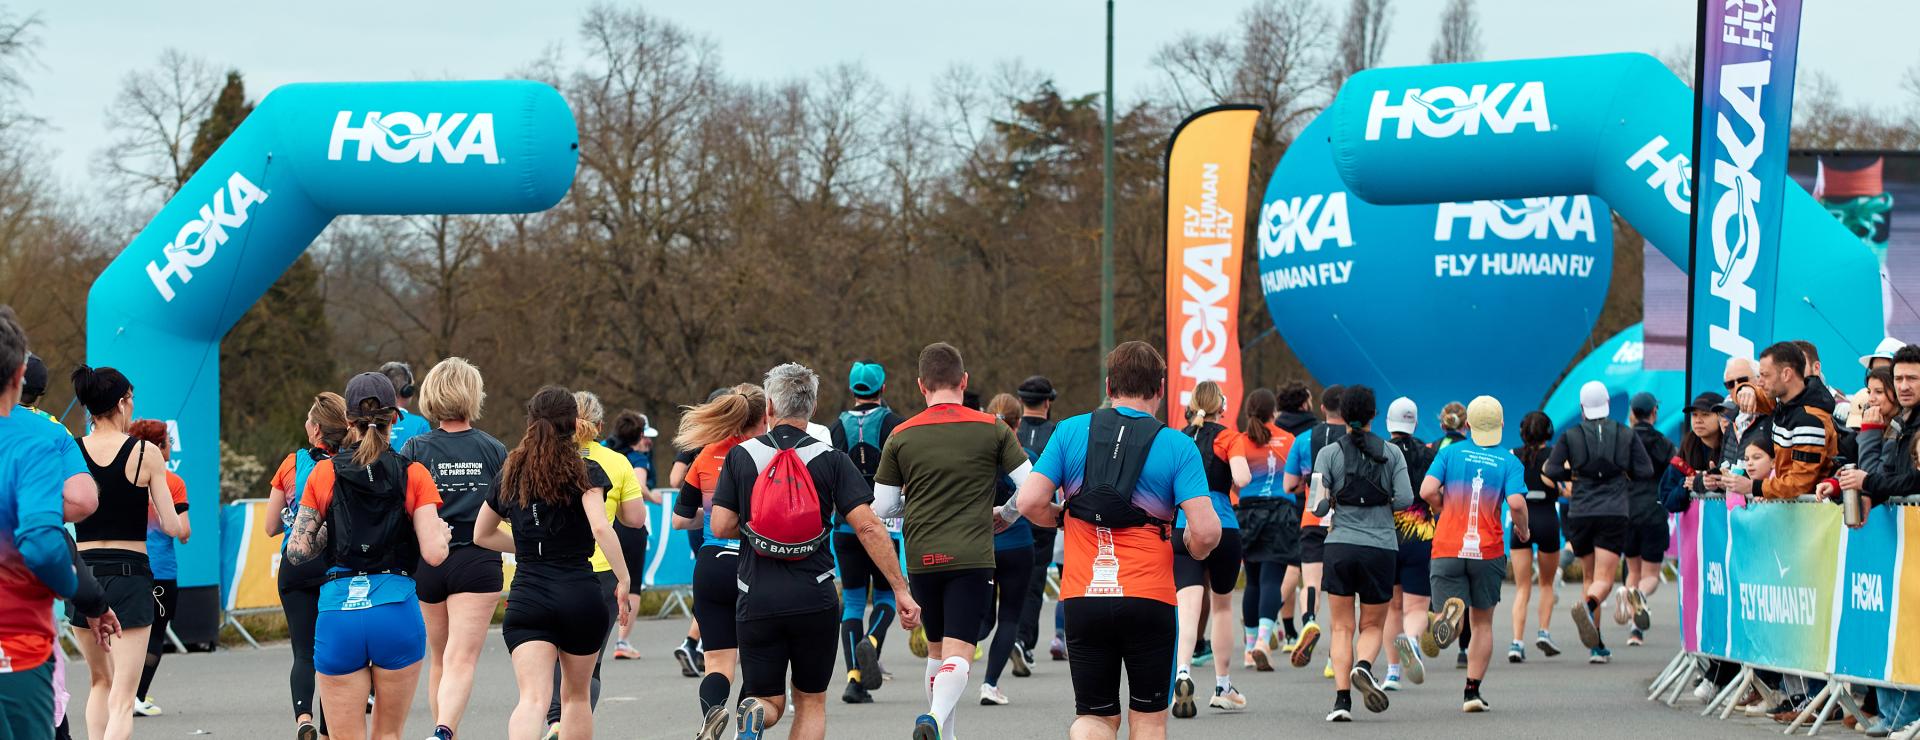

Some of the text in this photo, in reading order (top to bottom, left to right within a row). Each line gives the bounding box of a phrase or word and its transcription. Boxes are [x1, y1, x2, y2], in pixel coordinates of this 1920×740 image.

[1365, 81, 1551, 141] HOKA
[327, 110, 500, 164] HOKA
[1625, 134, 1692, 215] HO
[1183, 204, 1201, 238] FLY
[1200, 162, 1219, 238] HUMAN
[1434, 194, 1597, 243] HOKA
[1709, 60, 1772, 362] HOKA
[145, 171, 269, 303] HOKA
[1215, 207, 1233, 239] FLY
[1258, 191, 1353, 260] HOKA
[1318, 260, 1353, 286] FLY
[1435, 253, 1595, 277] FLY HUMAN FLY
[437, 462, 483, 470] SEMI-MARATHON
[755, 538, 814, 554] FC BAYERN
[1706, 561, 1725, 596] HOKA
[1851, 572, 1884, 612] HOKA
[1739, 583, 1817, 626] FLY HUMAN FLY
